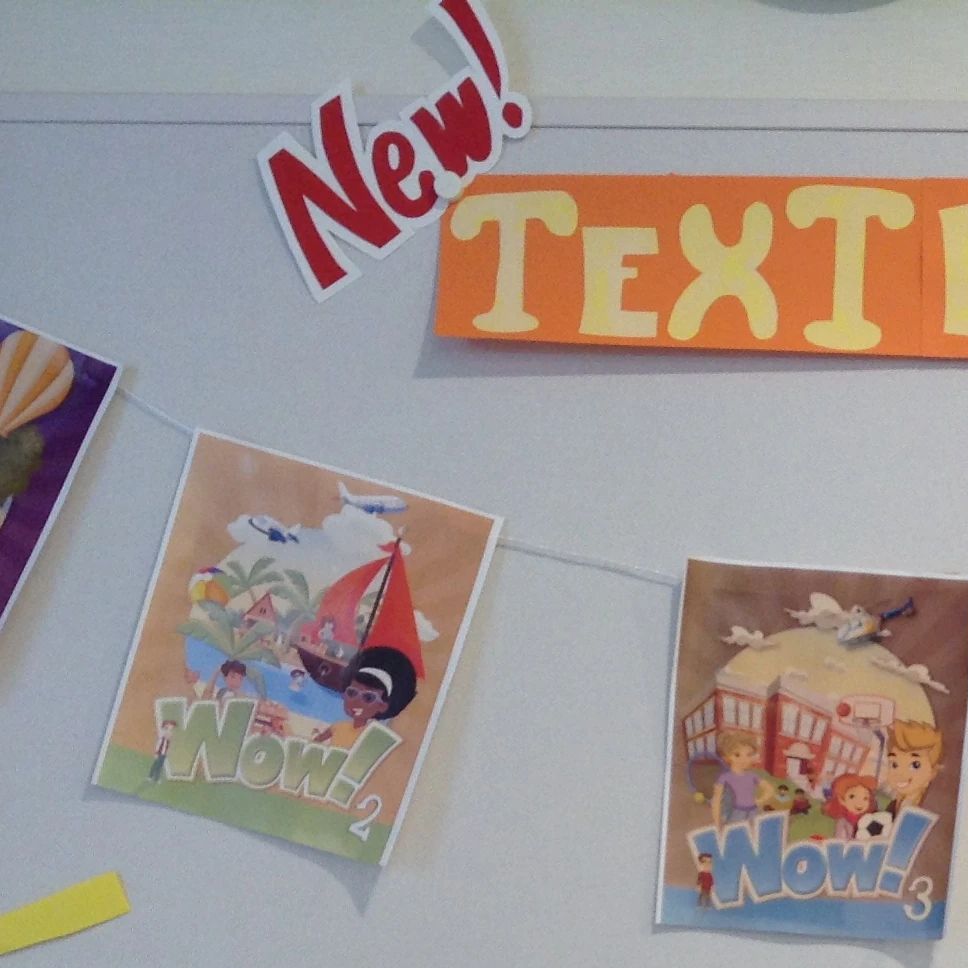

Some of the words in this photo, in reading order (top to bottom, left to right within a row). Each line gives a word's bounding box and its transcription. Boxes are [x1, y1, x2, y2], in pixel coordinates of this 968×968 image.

[267, 0, 524, 289] New!
[153, 696, 406, 806] Wow!
[350, 795, 384, 842] 2
[685, 810, 939, 909] Wow!
[905, 873, 935, 923] 3
